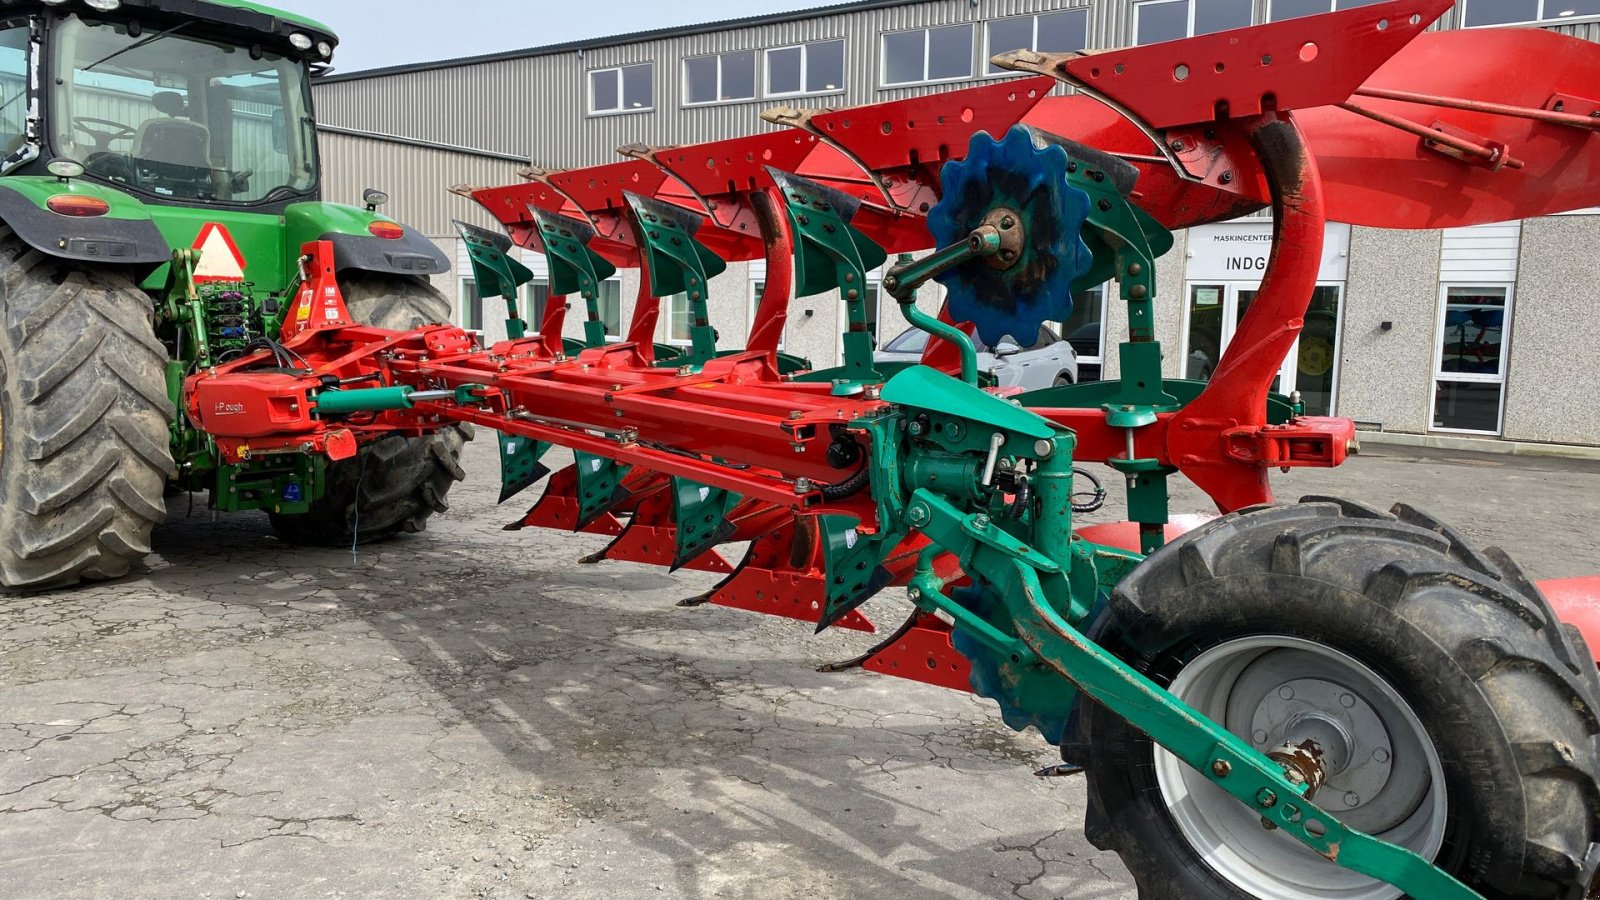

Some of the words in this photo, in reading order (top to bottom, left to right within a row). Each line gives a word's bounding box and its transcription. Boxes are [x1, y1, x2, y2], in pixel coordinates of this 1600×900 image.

[1213, 234, 1273, 242] MASKINCENTER
[1226, 256, 1266, 271] INDG
[215, 401, 244, 414] i-Pough
